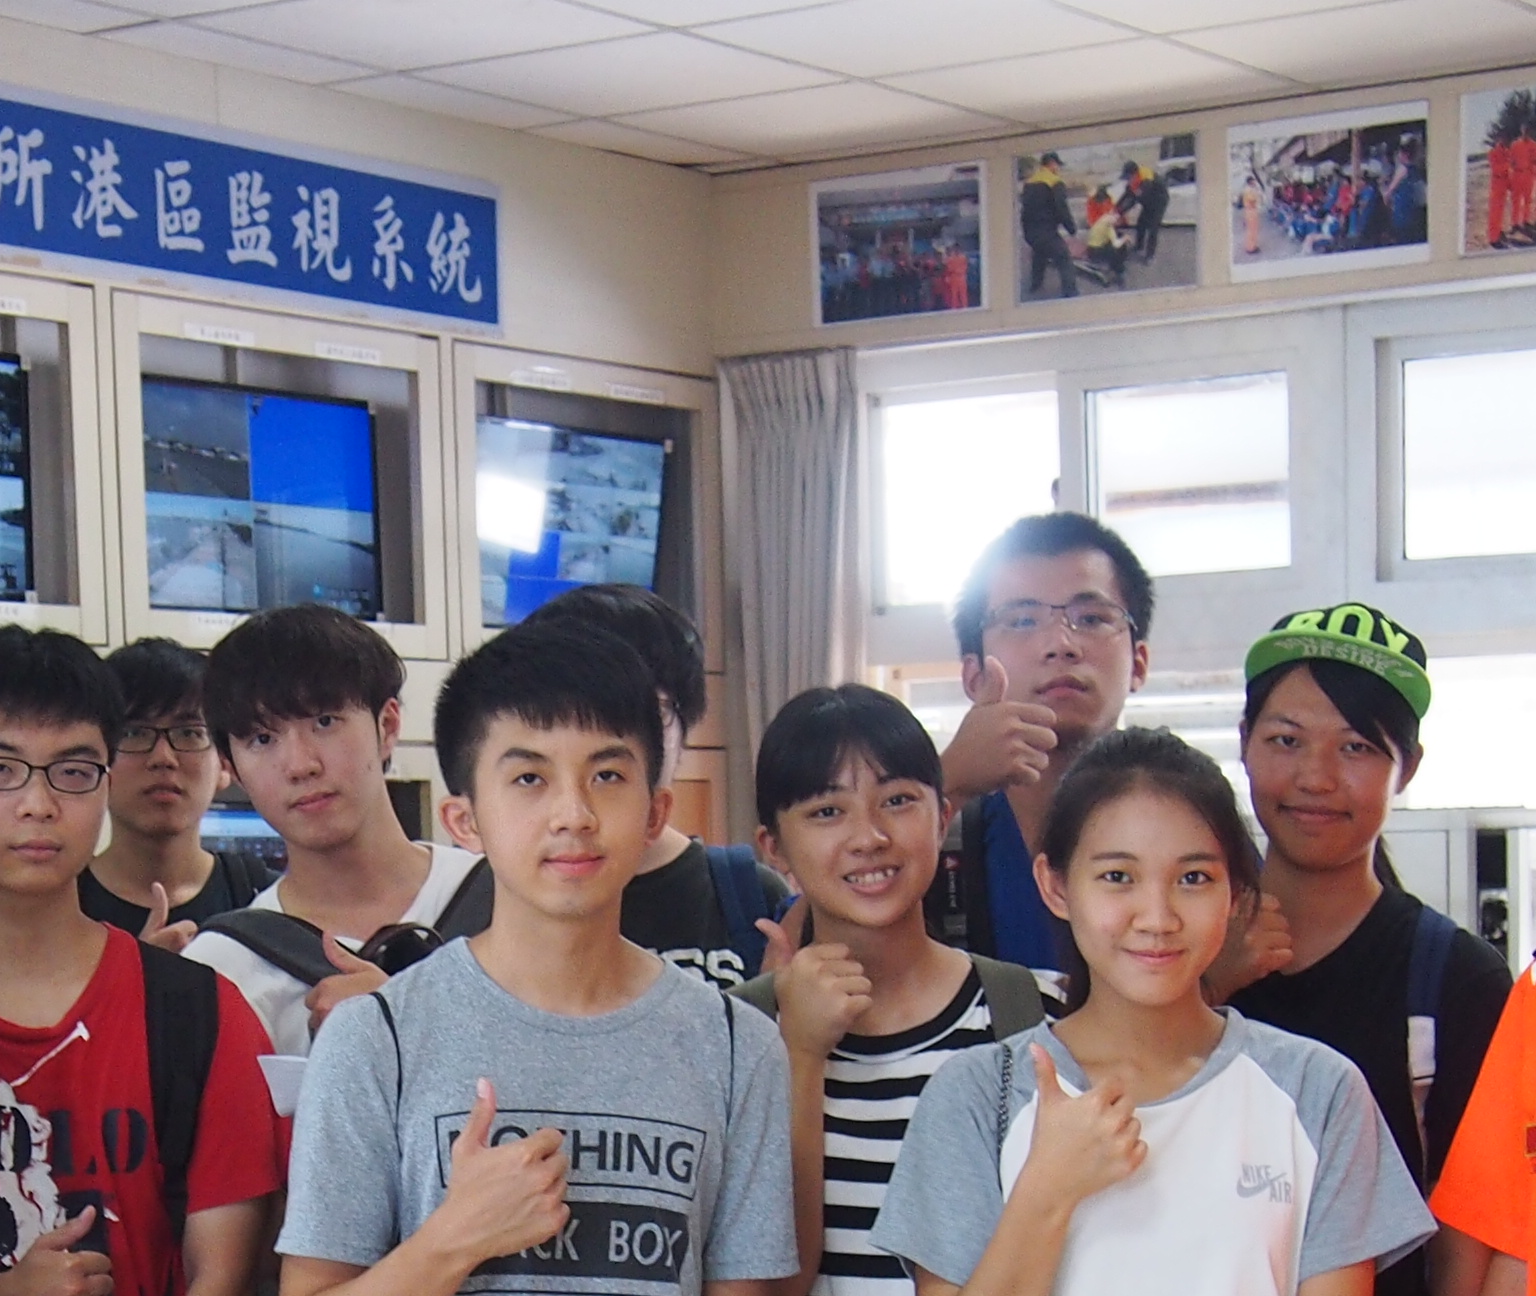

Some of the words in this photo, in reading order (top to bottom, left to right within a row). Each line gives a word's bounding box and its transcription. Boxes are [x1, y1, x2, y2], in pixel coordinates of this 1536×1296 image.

[1285, 604, 1410, 654] BOY
[1241, 1162, 1272, 1184] NIKE
[1269, 1180, 1292, 1204] AIR
[608, 1219, 683, 1268] BOY
